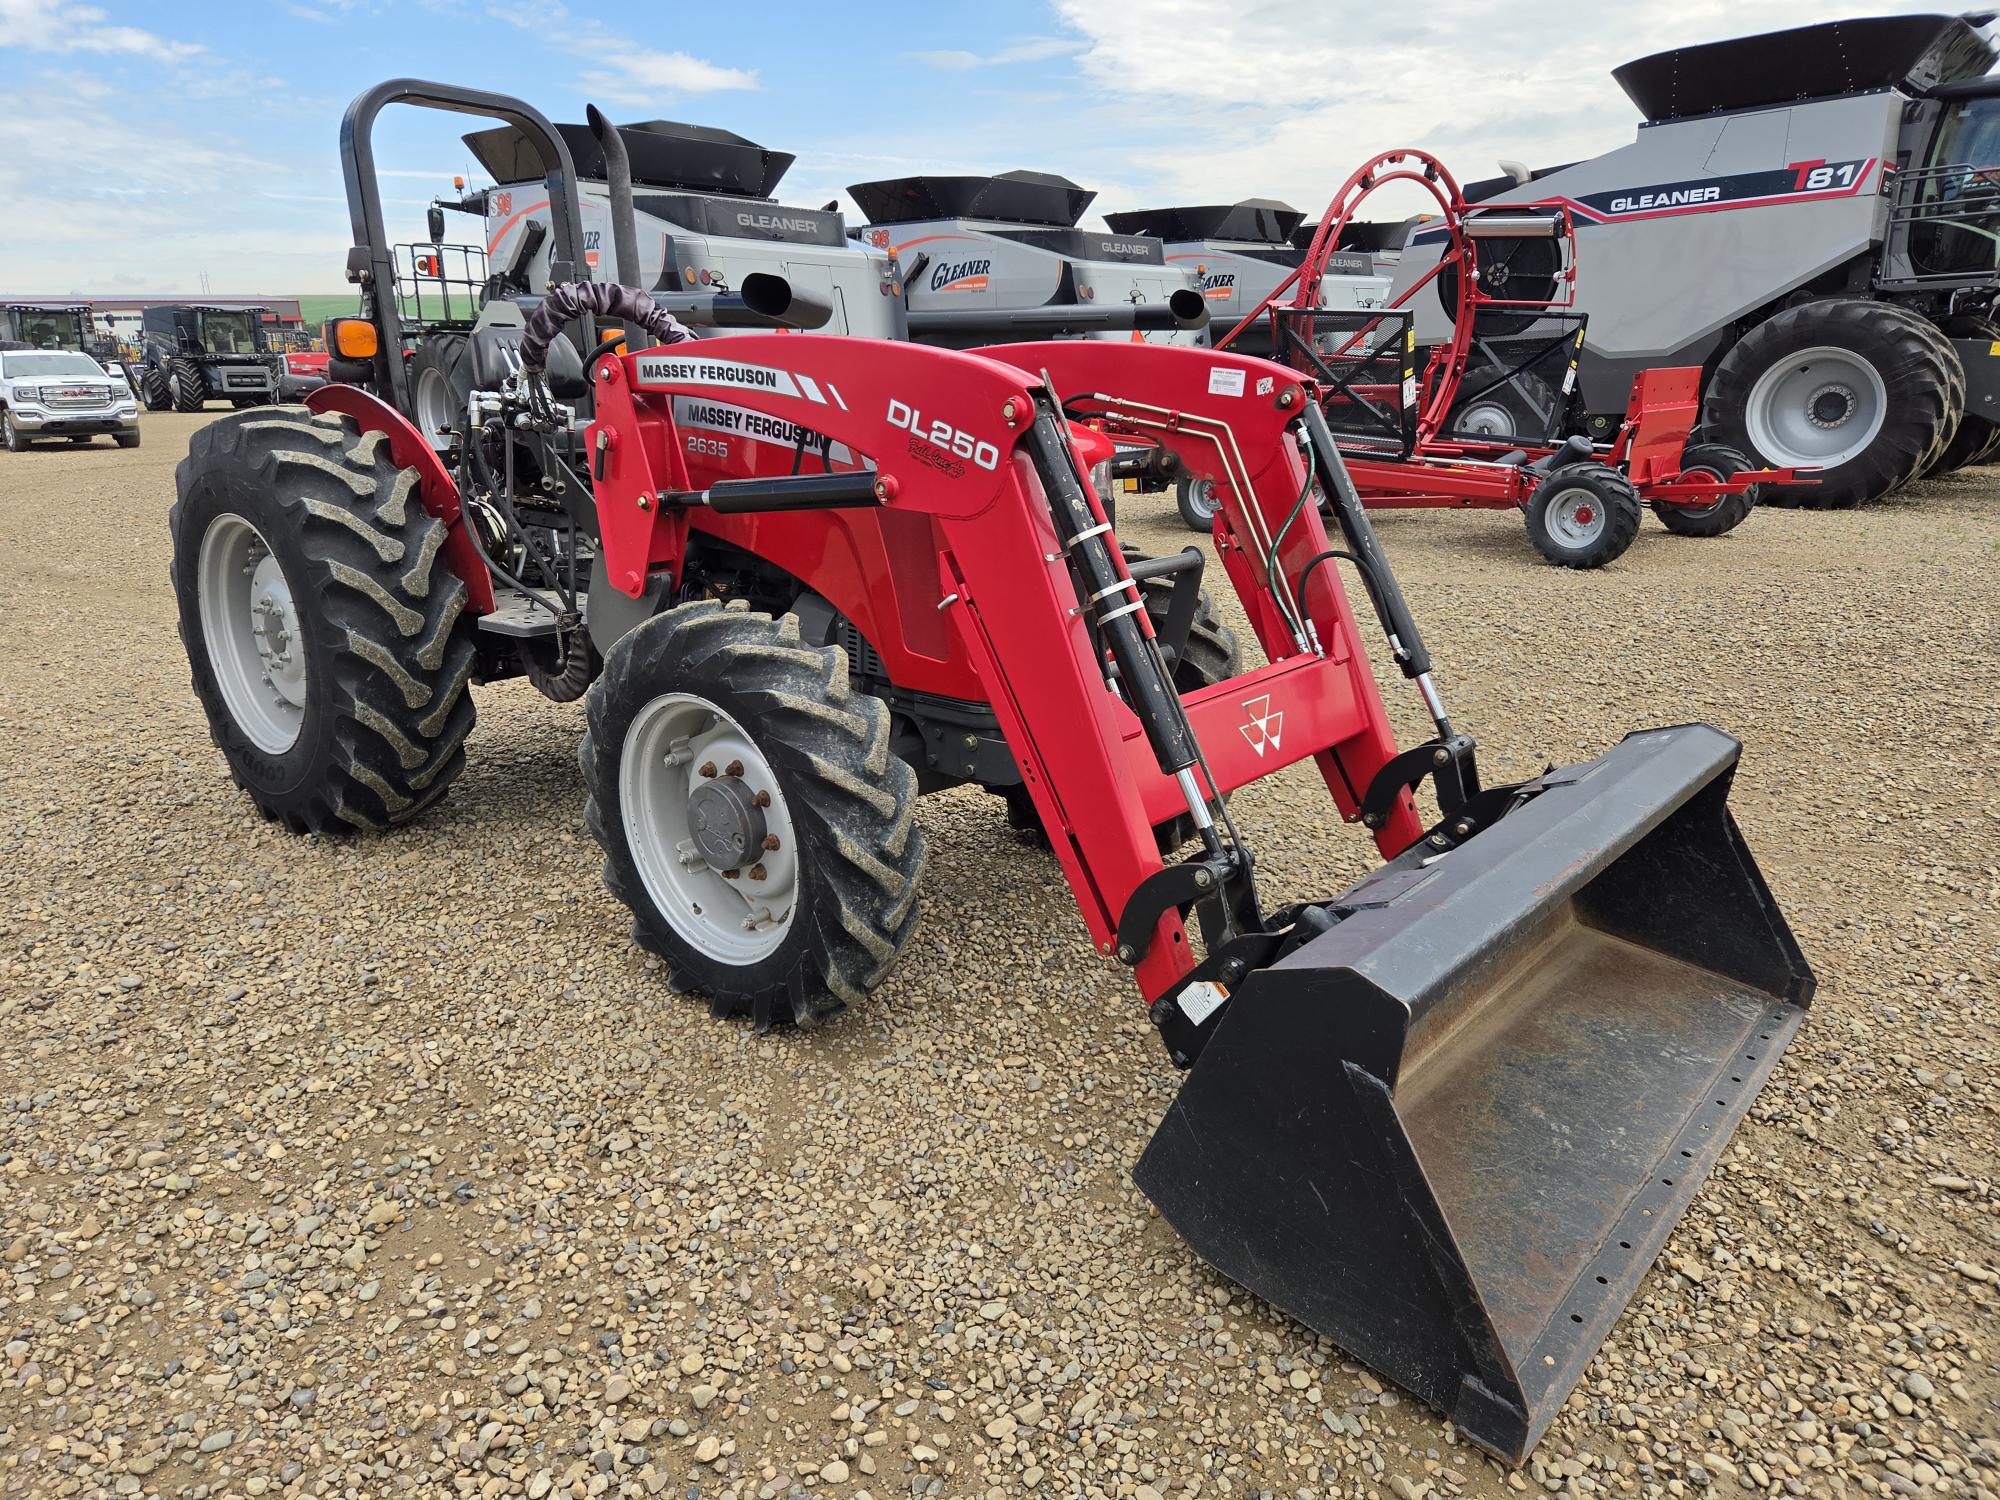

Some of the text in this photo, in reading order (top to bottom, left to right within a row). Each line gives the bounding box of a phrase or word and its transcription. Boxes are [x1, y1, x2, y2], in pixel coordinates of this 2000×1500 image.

[1787, 158, 1856, 191] T81
[490, 192, 512, 217] S98
[1610, 186, 1721, 212] GLEANER
[736, 213, 818, 233] GLEANER
[1101, 242, 1149, 256] GLEANER
[930, 259, 991, 291] GLEANER
[642, 364, 777, 388] MASSEY FERGUSON
[688, 404, 828, 451] MASSEY FERGUSON
[886, 397, 1000, 471] DL250
[687, 436, 729, 458] 2635
